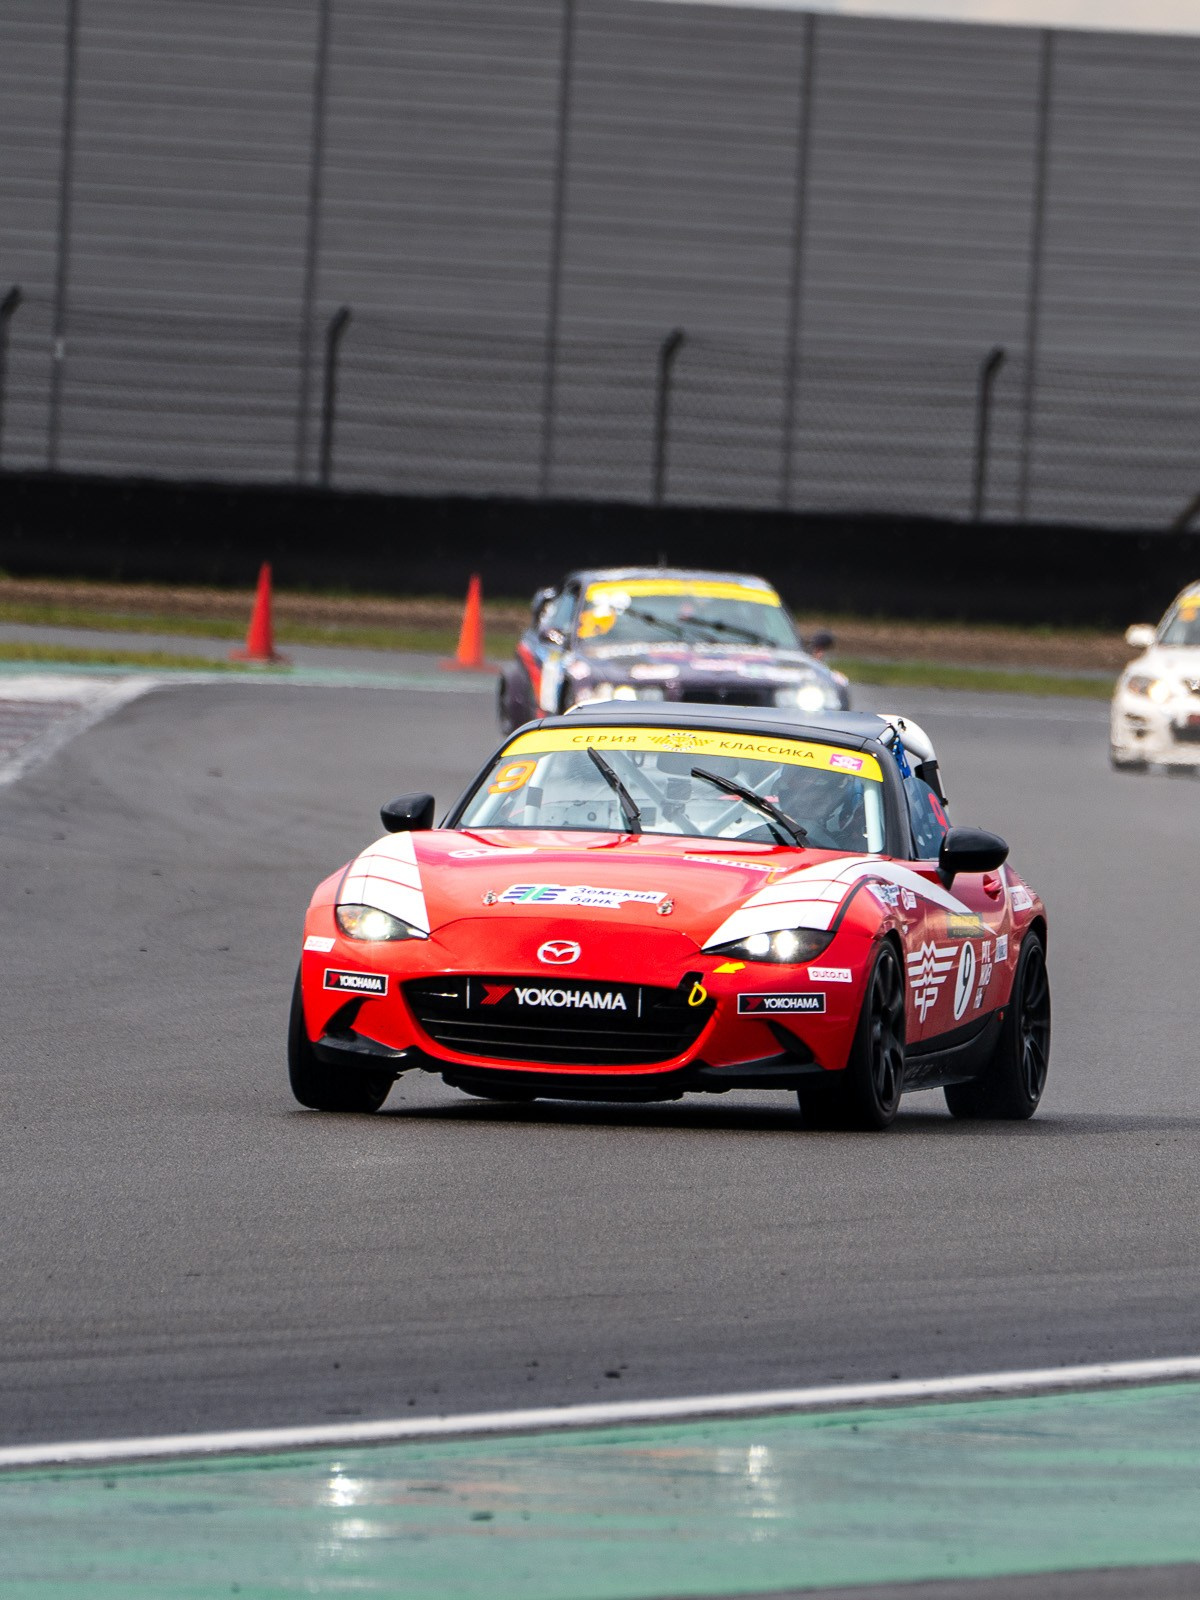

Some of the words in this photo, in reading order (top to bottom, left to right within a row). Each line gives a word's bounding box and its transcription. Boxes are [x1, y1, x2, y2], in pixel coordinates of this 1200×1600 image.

[572, 735, 637, 743] СЕРИЯ
[719, 741, 815, 759] КЛАССИКА
[487, 760, 537, 795] 9
[570, 896, 614, 905] банк
[339, 975, 382, 990] YOKOHAMA
[812, 970, 849, 979] auto.ru
[957, 944, 971, 1014] 9
[514, 987, 627, 1010] YOKOHAMA
[763, 998, 819, 1009] YOKOHAMA
